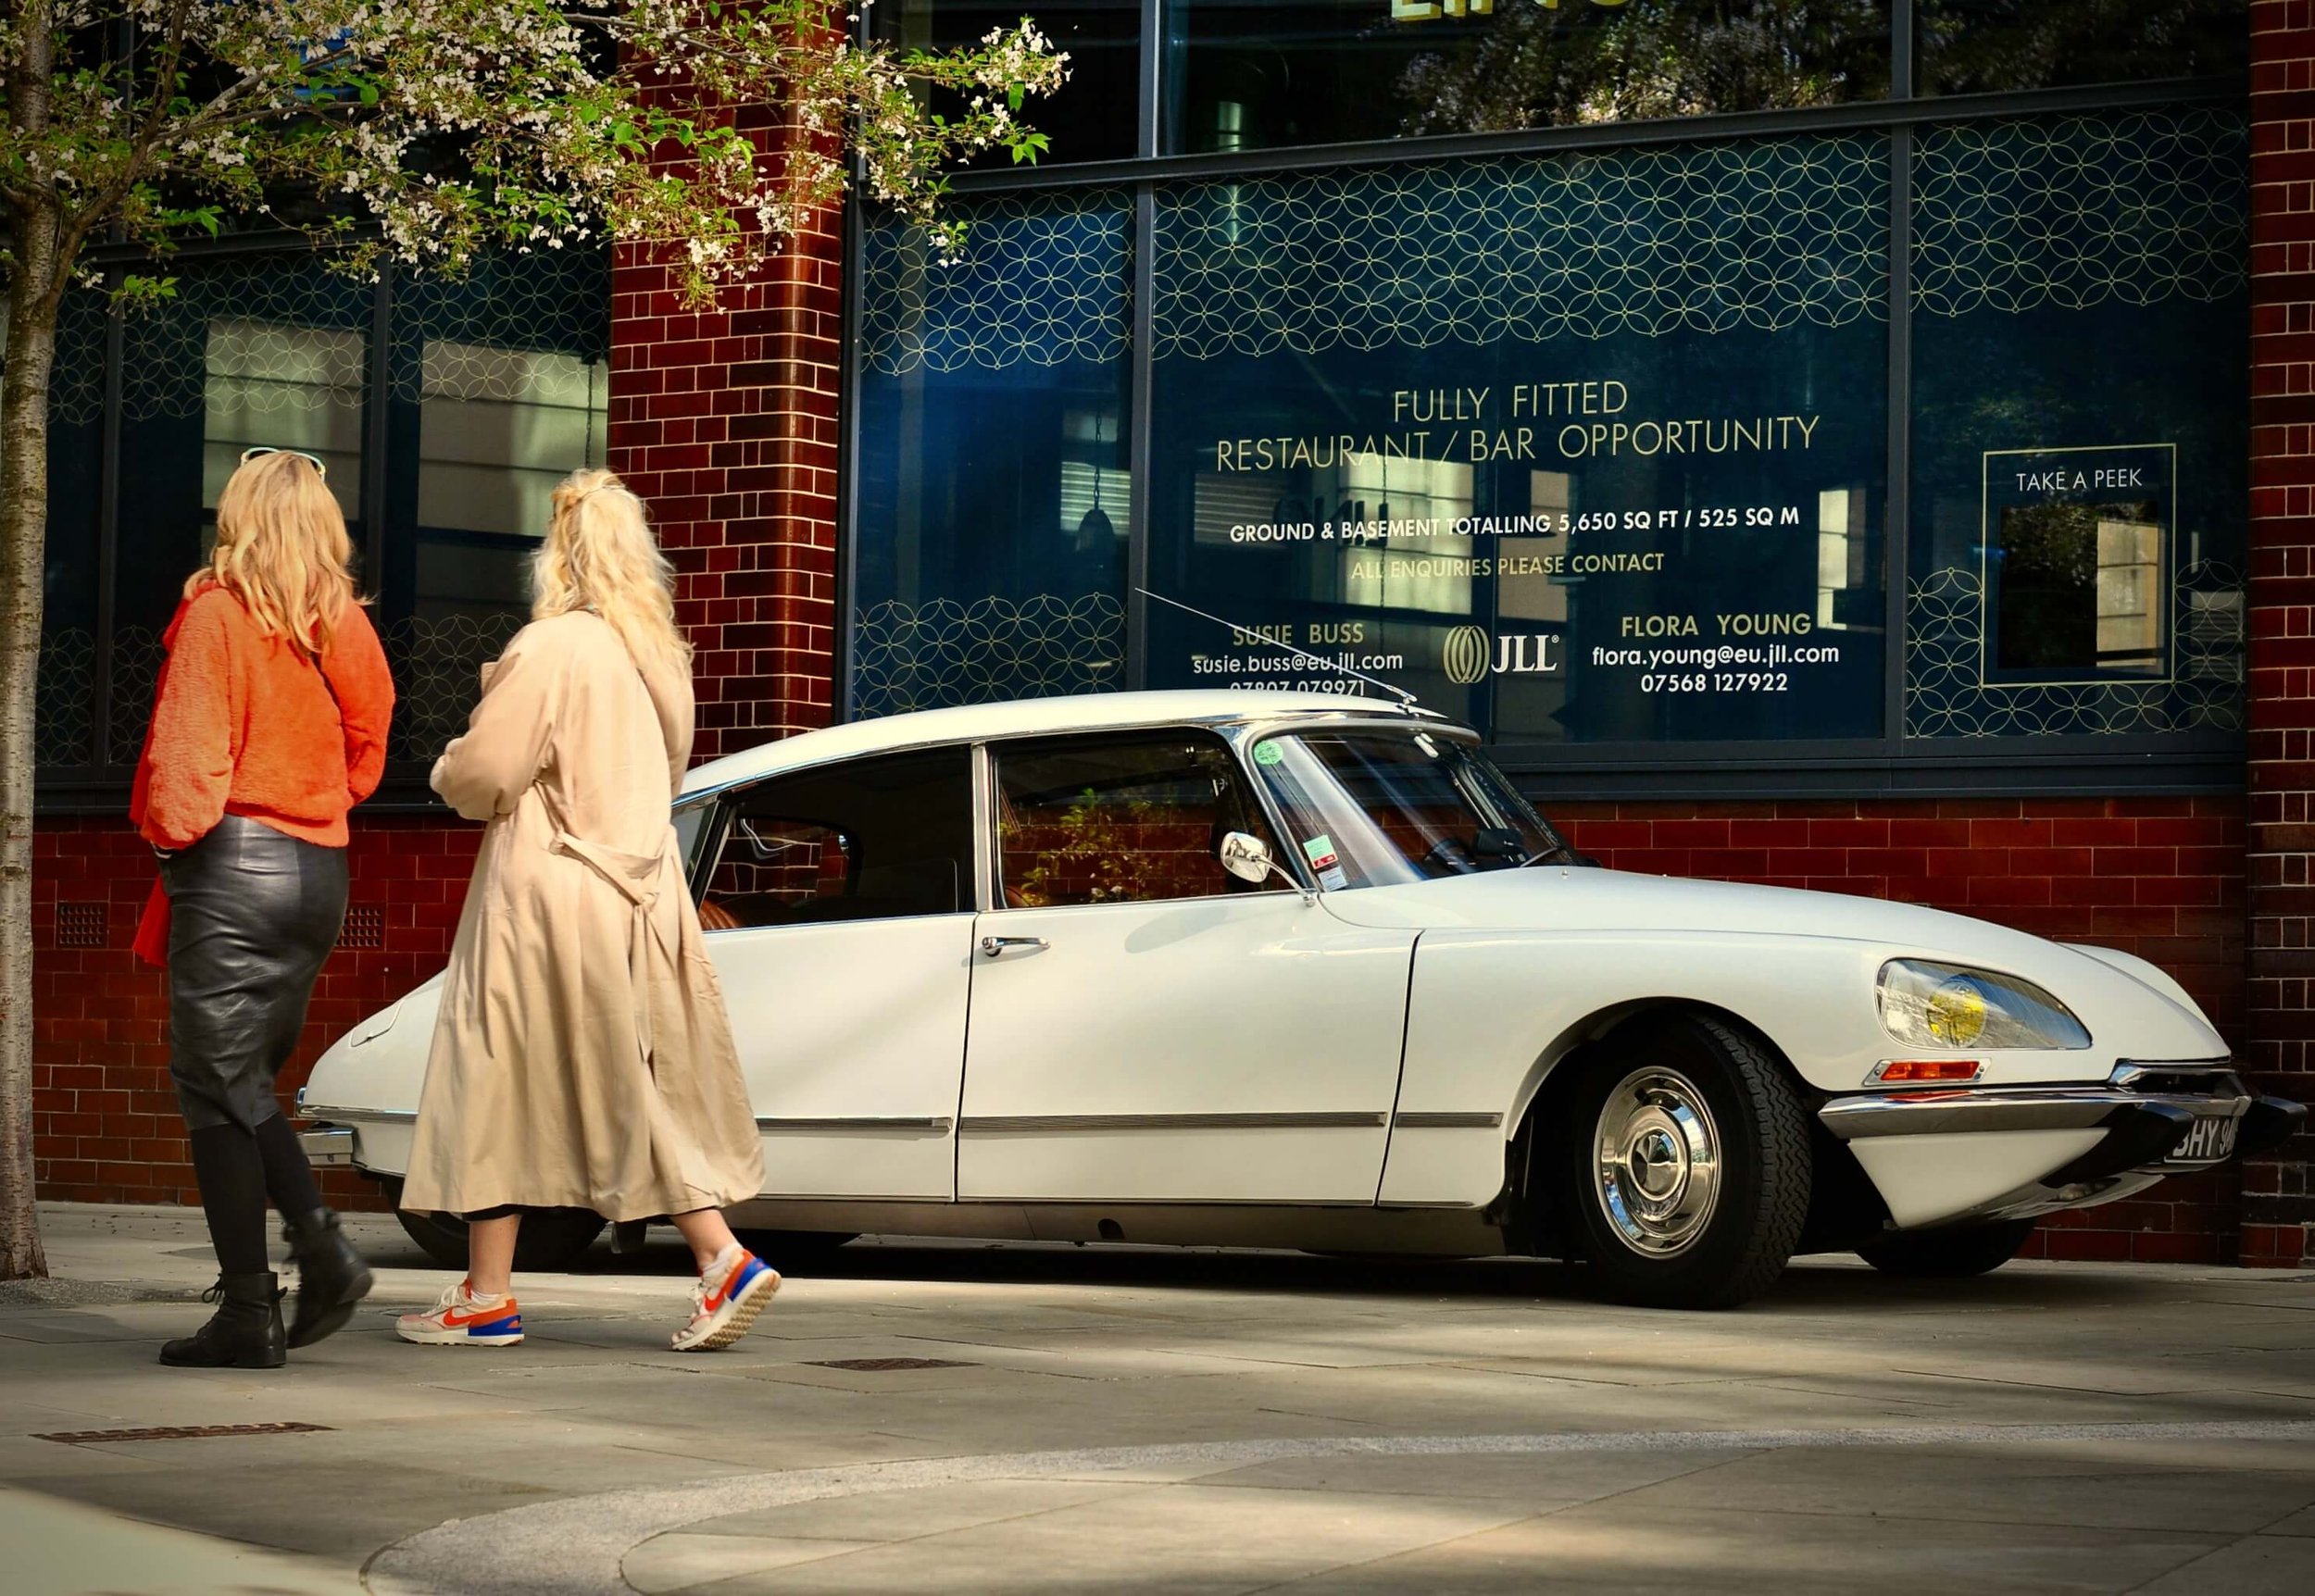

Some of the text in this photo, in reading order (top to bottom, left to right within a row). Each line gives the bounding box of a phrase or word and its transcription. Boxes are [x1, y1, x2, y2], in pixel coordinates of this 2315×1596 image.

[1394, 380, 1628, 423] FULLY FITTED
[1217, 415, 1821, 473] RESTAURANT / BAR OPPORTUNITY
[2015, 468, 2143, 492] TAKE A PEEK
[1229, 506, 1800, 543] GROUND & BASEMENT TOTALLING 5,650 SQ FT / 525 SQ M
[1351, 553, 1665, 580] ALL ENQUIRIES PLEASE CONTACT
[1232, 622, 1365, 646] SUSIE BUSS
[1620, 612, 1812, 638] FLORA YOUNG
[1192, 652, 1404, 676] susie.buss@eu.jll.com
[1591, 642, 1840, 670] flora.young@eu.jll.com
[1296, 679, 1365, 697] 079971
[1640, 672, 1788, 692] 07568 127922
